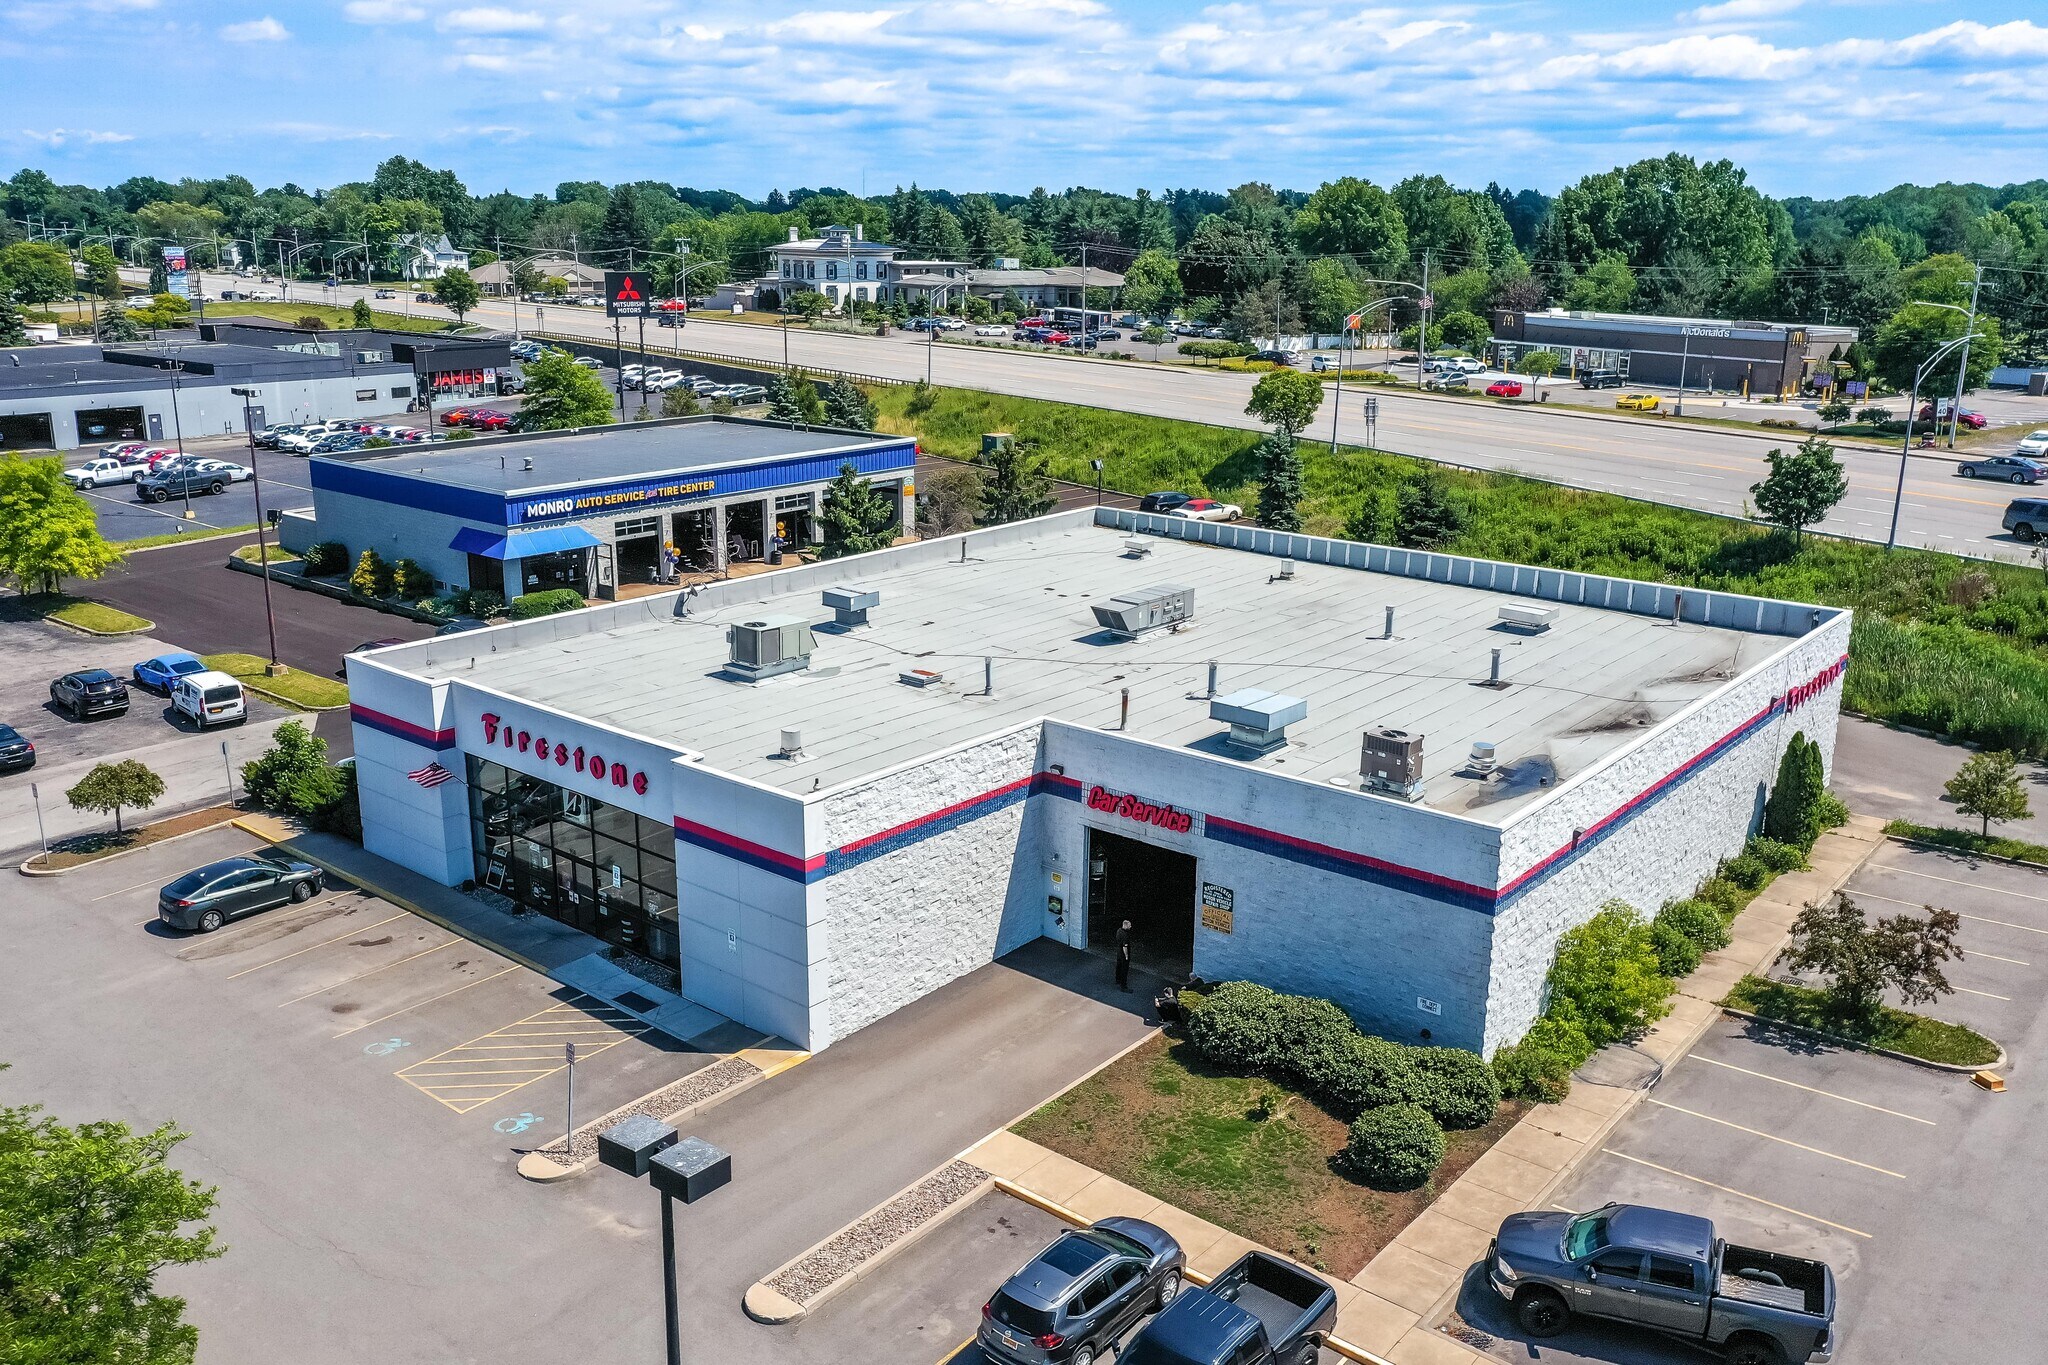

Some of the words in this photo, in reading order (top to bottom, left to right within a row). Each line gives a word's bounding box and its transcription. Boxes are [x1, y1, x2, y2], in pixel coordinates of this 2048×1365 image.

[1681, 327, 1730, 338] McDonald's
[433, 369, 484, 387] JAMES
[527, 499, 574, 518] MONRO
[575, 497, 603, 509] AUTO
[604, 490, 645, 506] SERVICE
[658, 486, 679, 497] TIRE
[680, 480, 715, 494] CENTER
[481, 713, 648, 795] Firestone
[1087, 786, 1119, 813] Car
[1119, 795, 1192, 833] Service
[1203, 885, 1232, 899] REGISTERED
[1204, 909, 1231, 921] OFFICIAL
